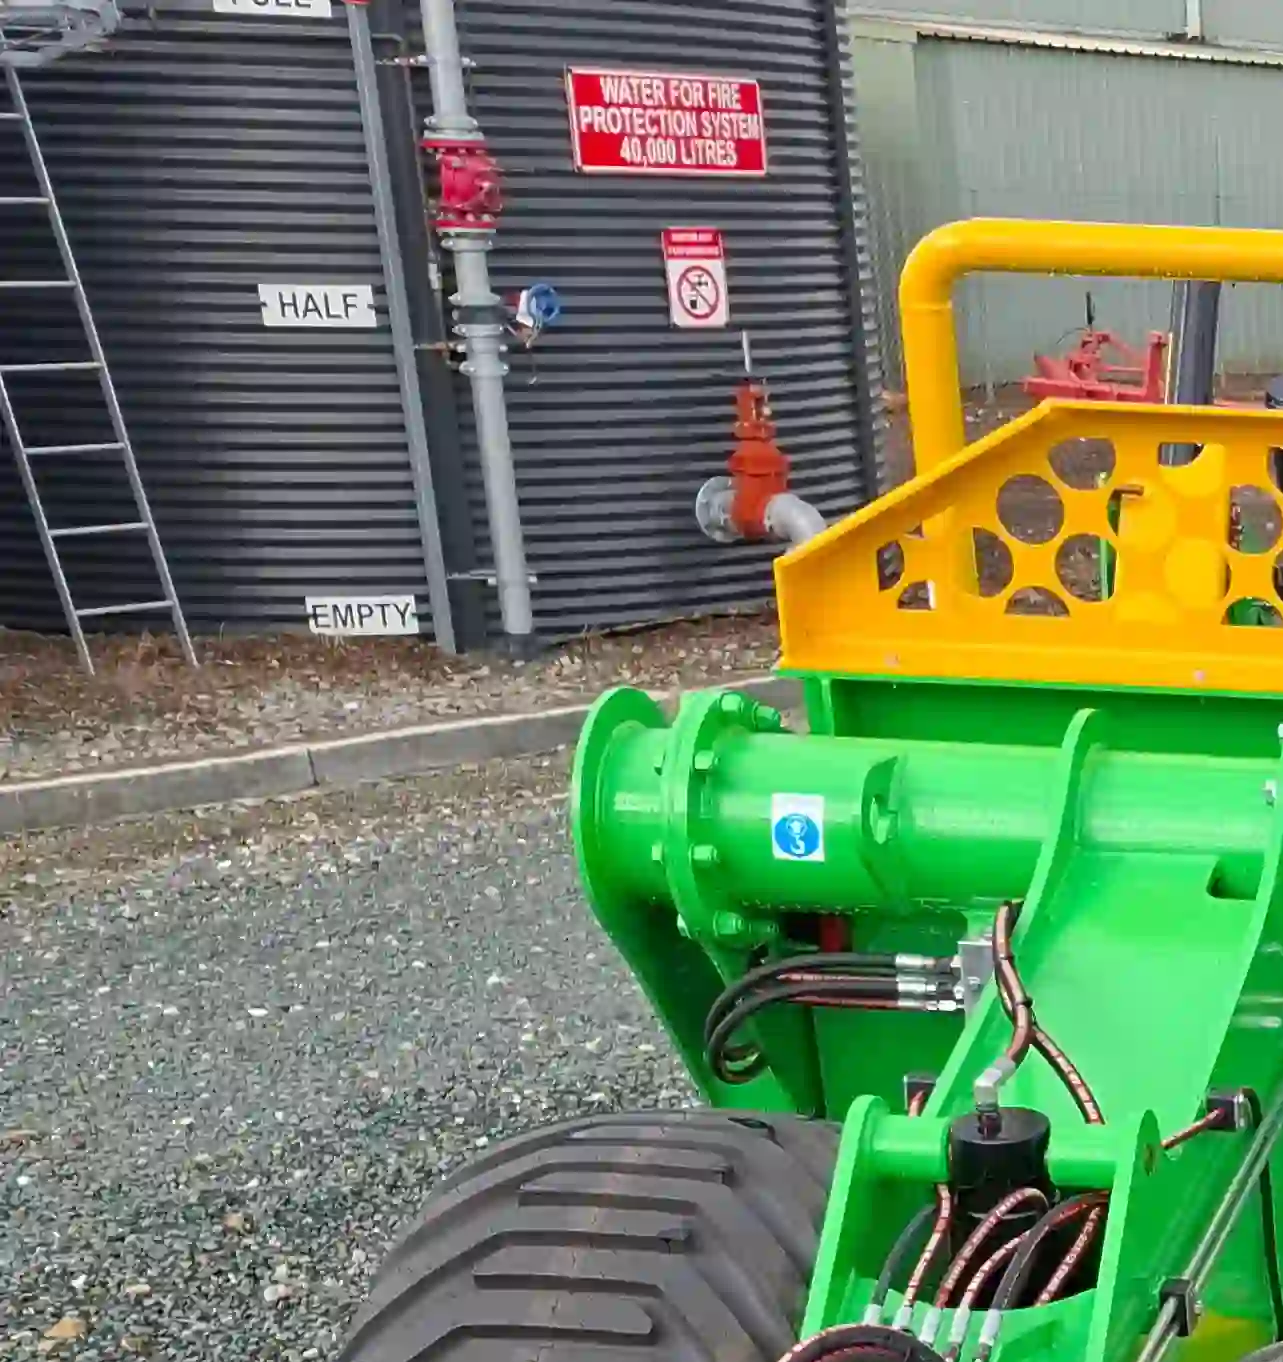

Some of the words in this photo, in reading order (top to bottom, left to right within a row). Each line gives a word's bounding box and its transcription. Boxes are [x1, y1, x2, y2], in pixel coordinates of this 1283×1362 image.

[600, 76, 666, 104] WATER
[669, 79, 705, 108] FOR
[707, 81, 742, 110] FIRE
[579, 105, 698, 137] PROTECTION
[701, 111, 761, 140] SYSTEM
[620, 136, 676, 167] 40,000
[680, 139, 738, 167] LITRES
[278, 291, 358, 320] HALF
[311, 602, 410, 629] EMPTY
